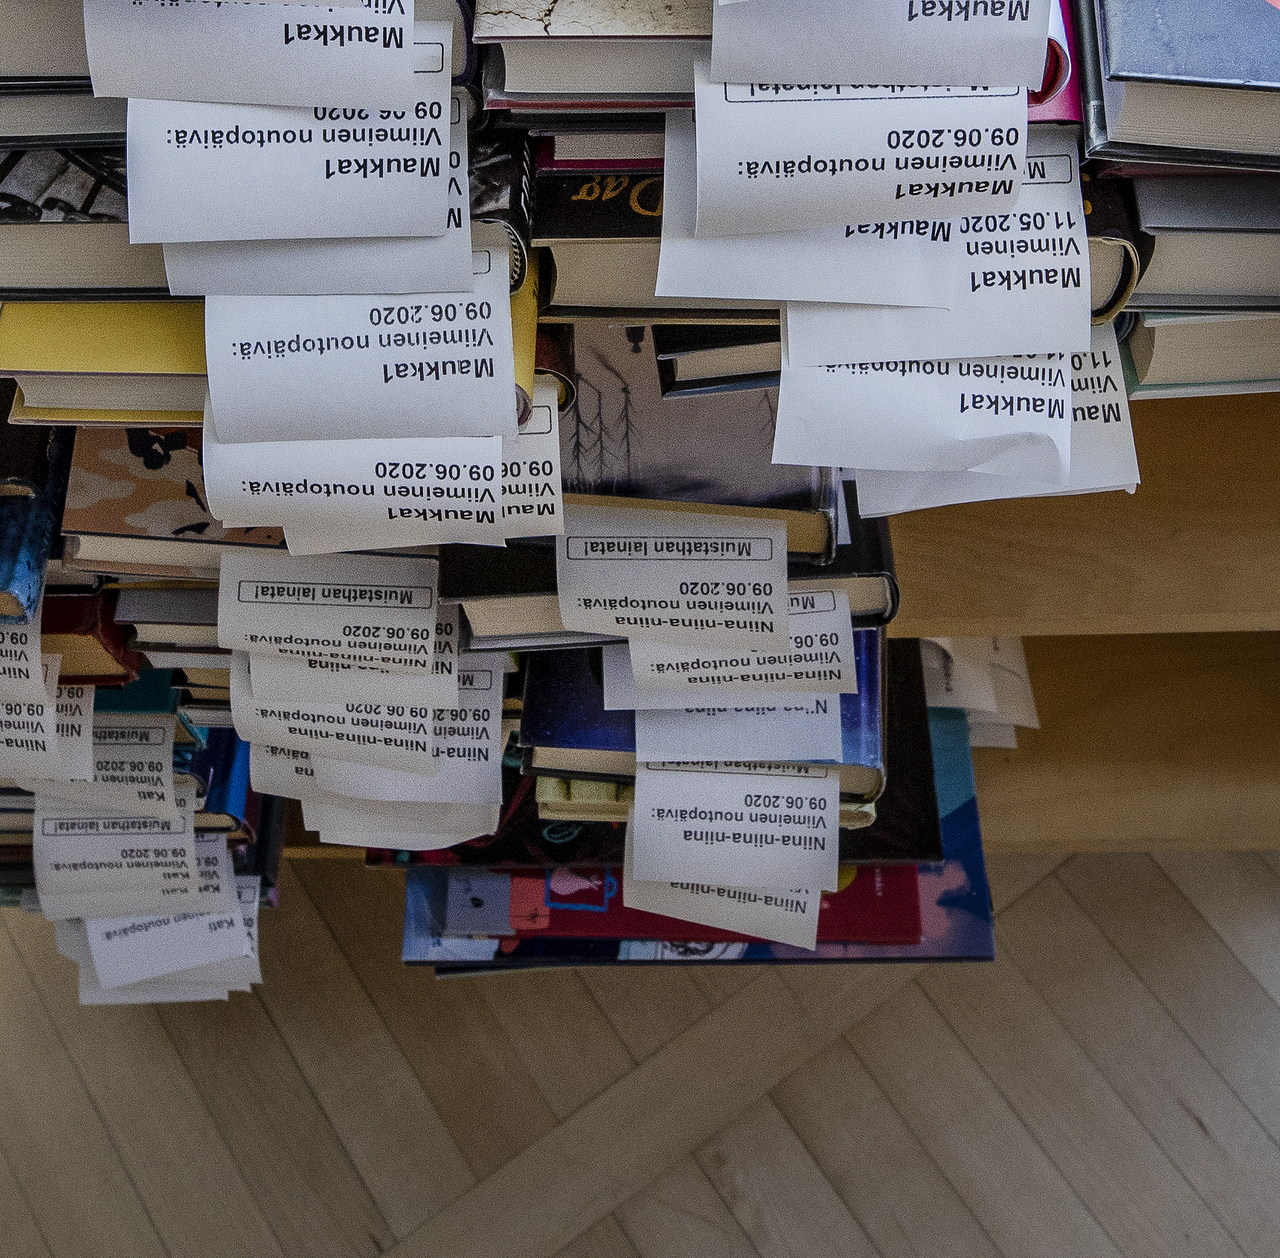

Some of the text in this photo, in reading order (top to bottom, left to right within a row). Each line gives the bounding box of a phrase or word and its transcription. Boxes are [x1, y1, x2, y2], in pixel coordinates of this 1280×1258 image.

[886, 127, 1019, 150] 09.06.2020
[738, 154, 1017, 178] Viimeinen noutopäivä:
[894, 179, 1013, 199] Maukka1
[960, 211, 1075, 234] 11.05.2020
[965, 237, 1080, 257] Viimeinen
[970, 267, 1080, 292] Maukka1
[369, 302, 492, 326] 09.06.2020
[232, 329, 492, 359] Viimeinen noutopäivä:
[382, 357, 494, 383] Maukka1
[584, 540, 751, 556] Muistathan lainata!
[322, 586, 412, 605] Muistathan
[679, 582, 773, 596] 09.06.2020
[686, 599, 774, 614] Viimeinen
[342, 625, 430, 640] 09.06.2020
[615, 616, 774, 633] Niina-niina-niina
[347, 640, 428, 655] Viimeinen
[279, 648, 426, 668] Niina-niina-niina
[744, 794, 827, 810] 09.06.2020
[749, 813, 827, 829] Viimeinen
[684, 830, 826, 851] Niina-niina-niina
